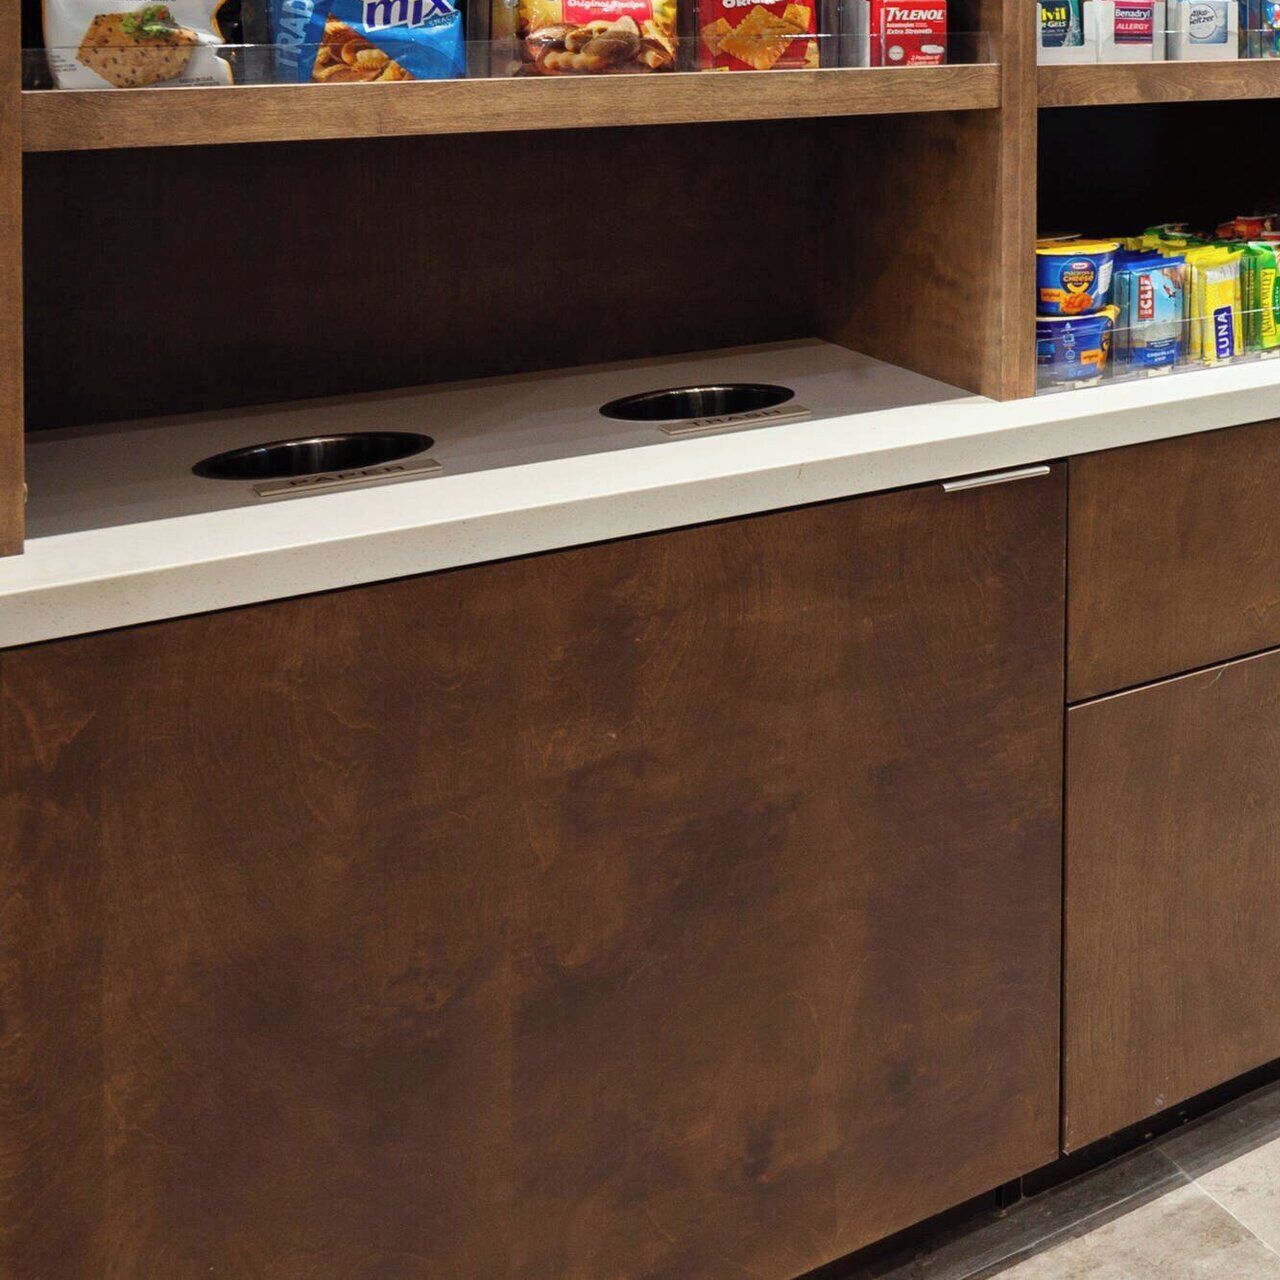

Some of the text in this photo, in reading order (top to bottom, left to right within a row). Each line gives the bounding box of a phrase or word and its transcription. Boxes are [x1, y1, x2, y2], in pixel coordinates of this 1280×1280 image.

[886, 7, 944, 22] TYLENOL
[1115, 9, 1151, 18] Benadryl
[1218, 311, 1230, 358] LUNA
